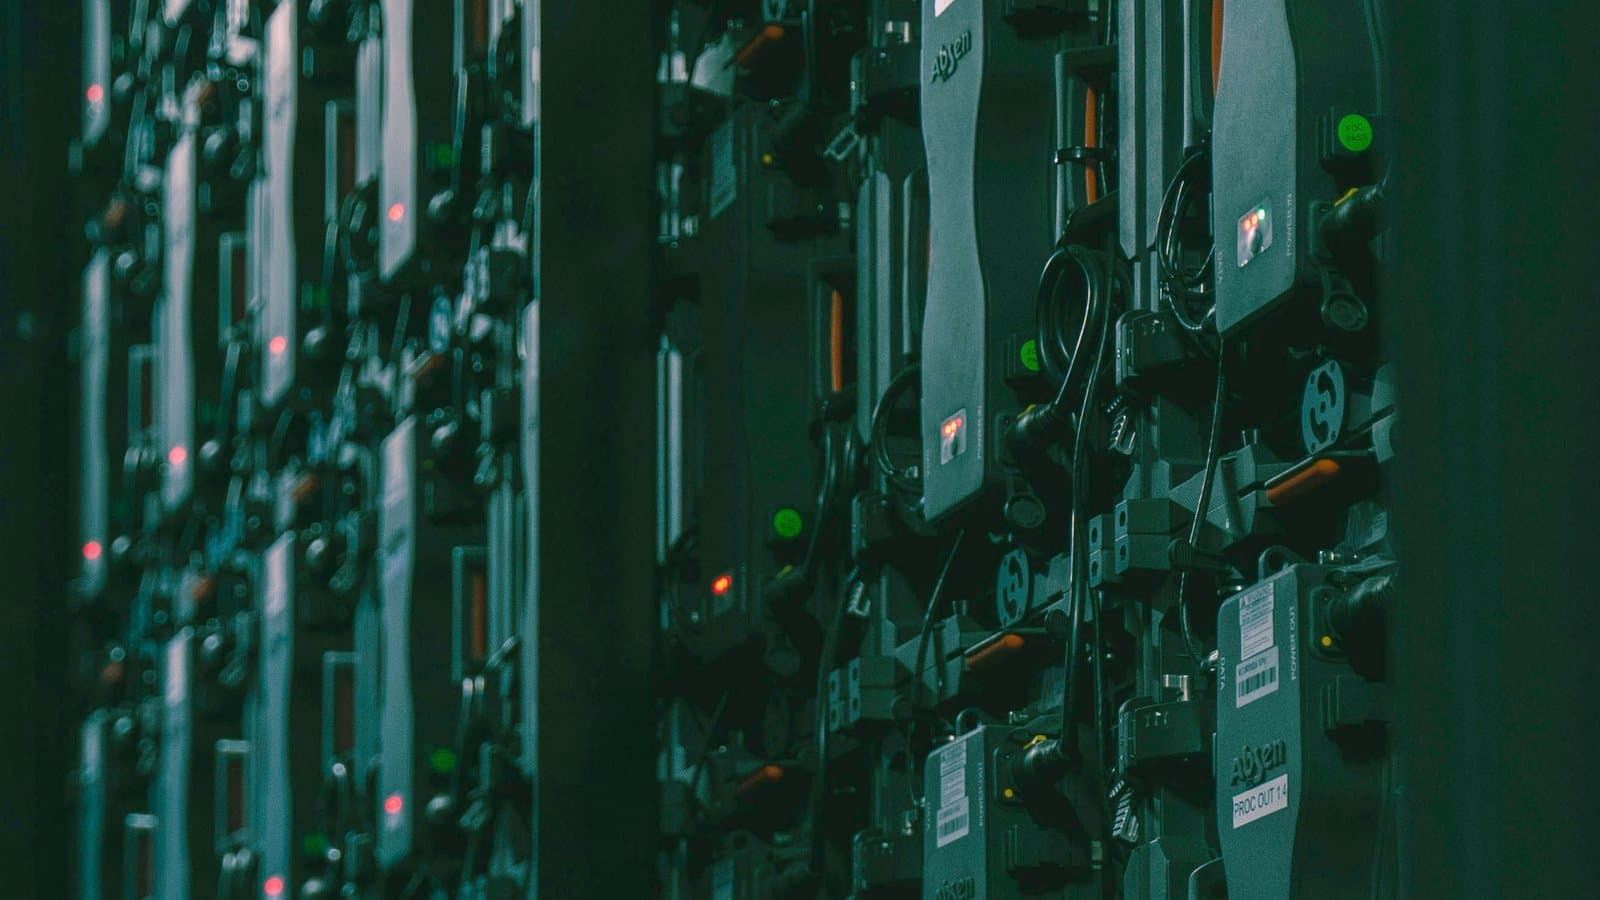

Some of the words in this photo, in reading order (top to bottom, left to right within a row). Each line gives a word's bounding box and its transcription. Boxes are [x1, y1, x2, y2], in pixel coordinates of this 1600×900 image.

[931, 30, 971, 83] Absen
[1289, 605, 1297, 631] OUT
[1289, 633, 1297, 680] POWER
[1231, 740, 1286, 786] Absen
[1234, 796, 1257, 816] PROC
[1257, 787, 1275, 809] OUT
